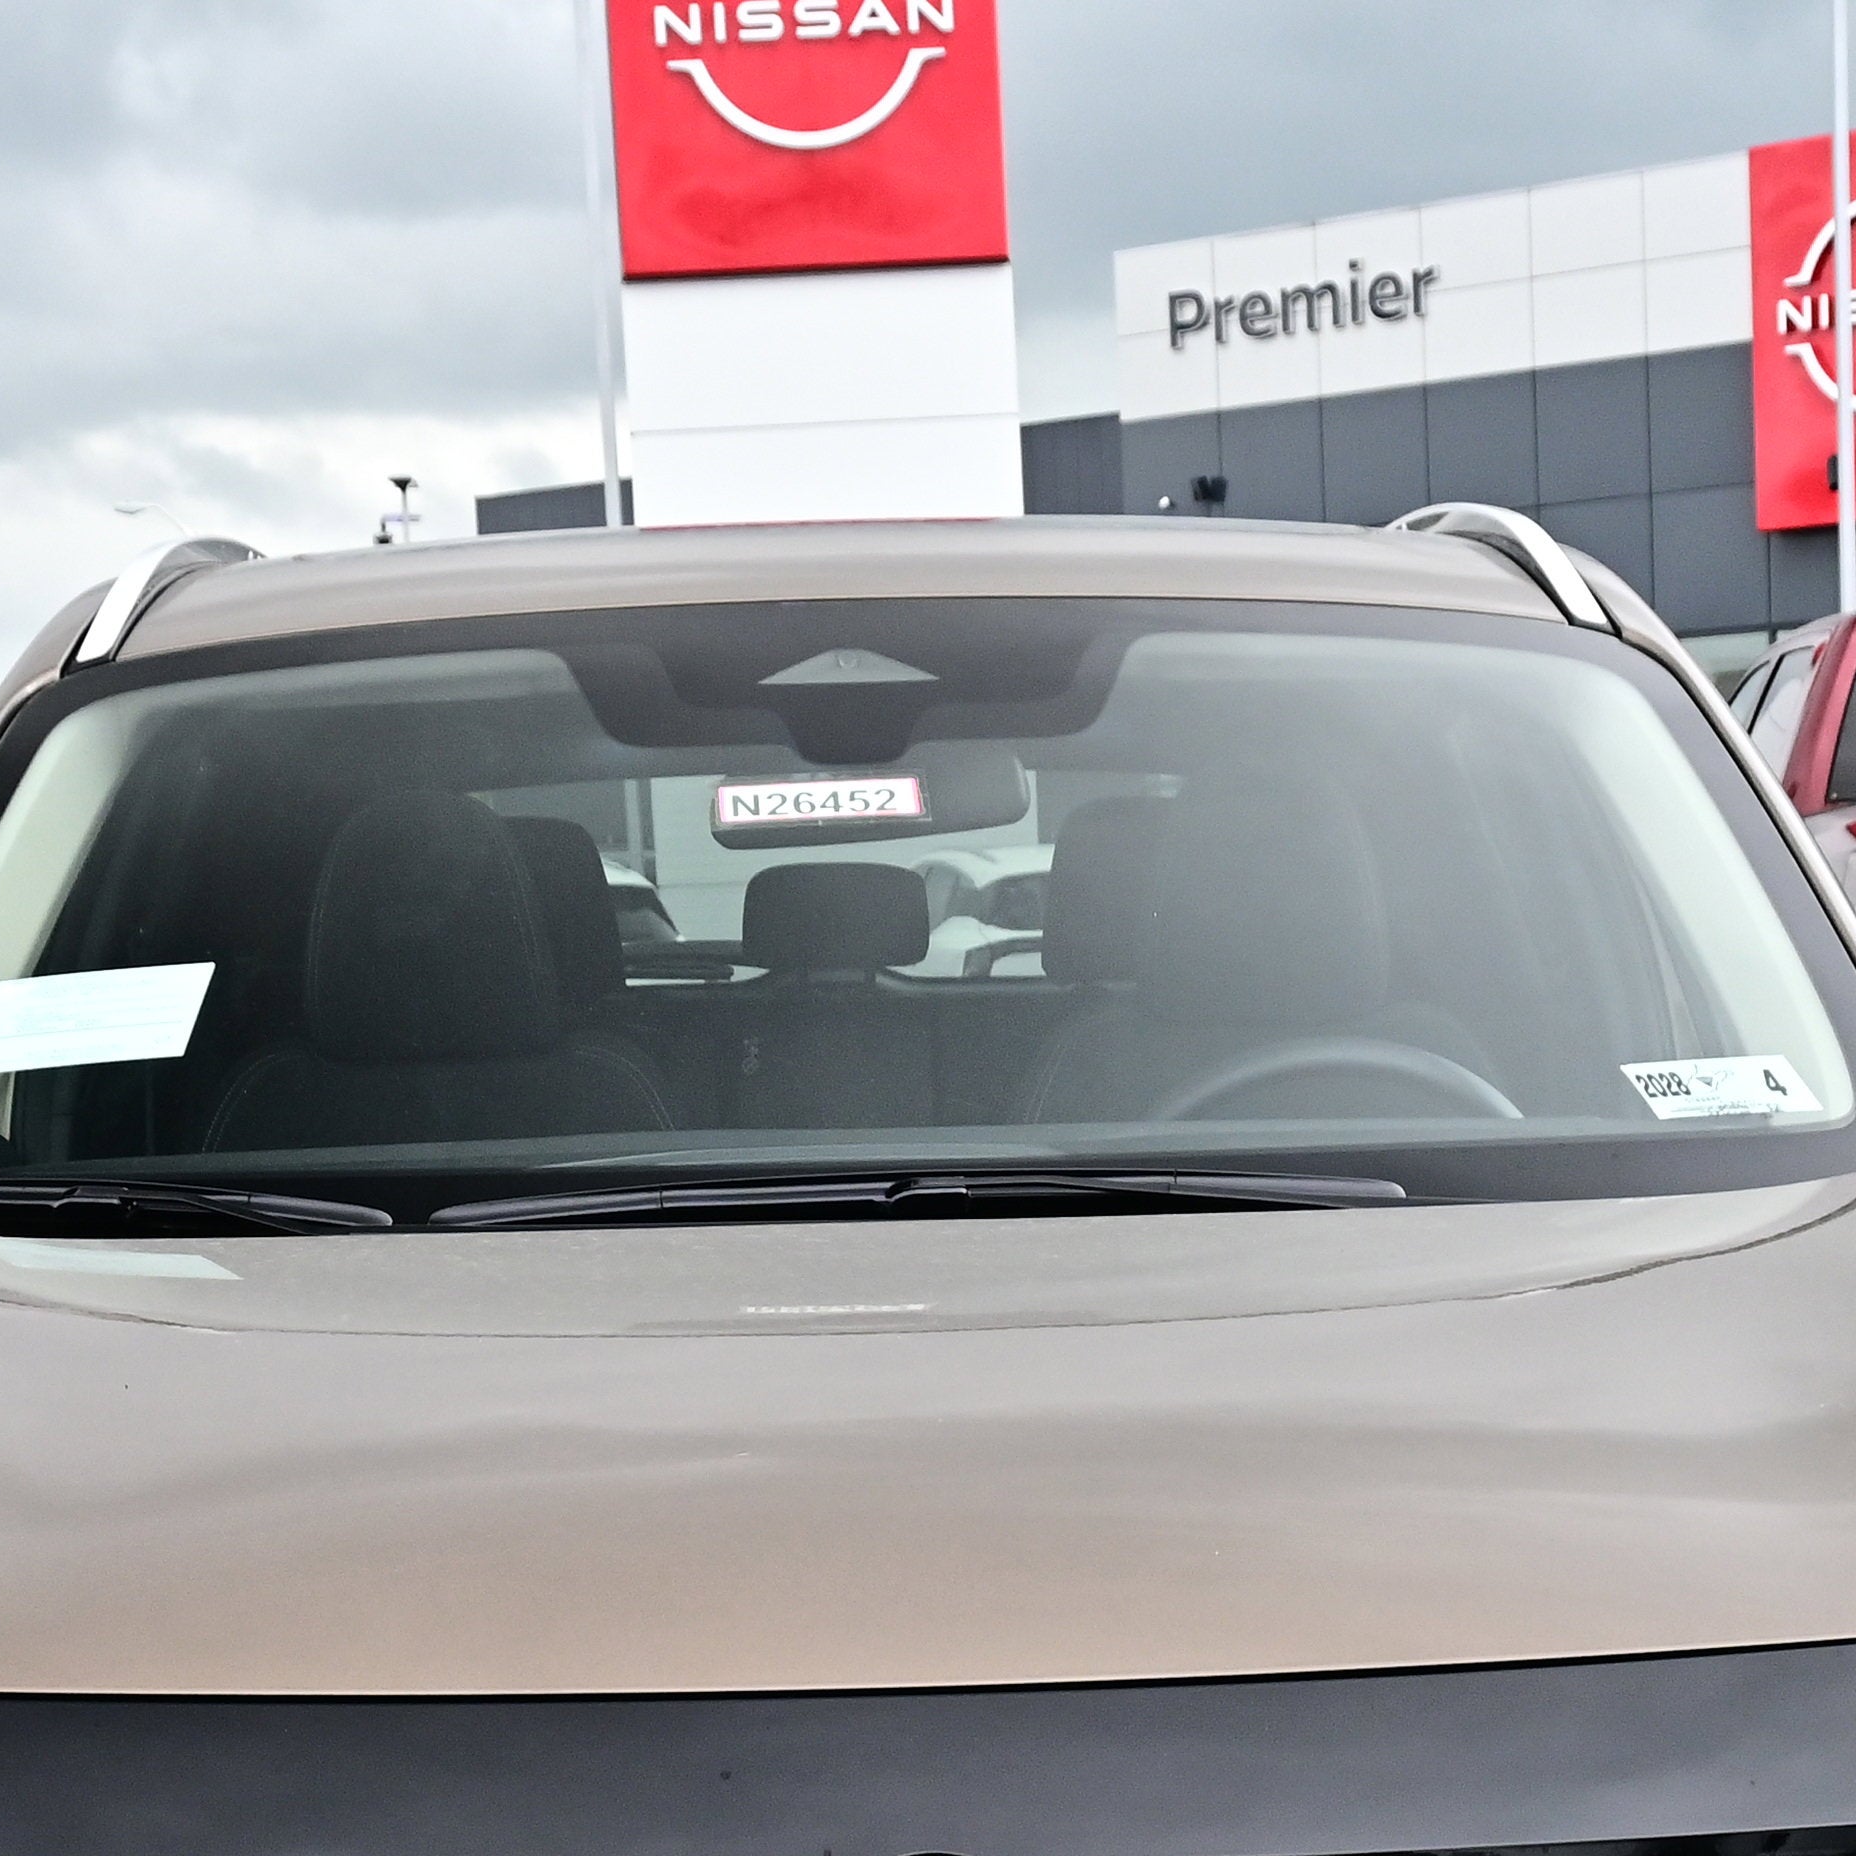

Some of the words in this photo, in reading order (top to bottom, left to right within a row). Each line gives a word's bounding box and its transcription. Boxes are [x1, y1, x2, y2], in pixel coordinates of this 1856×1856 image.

[653, 0, 955, 47] NISSAN
[1168, 257, 1440, 350] Premier
[731, 788, 898, 817] N26452
[1635, 1071, 1692, 1098] 2028
[1763, 1069, 1788, 1096] 4
